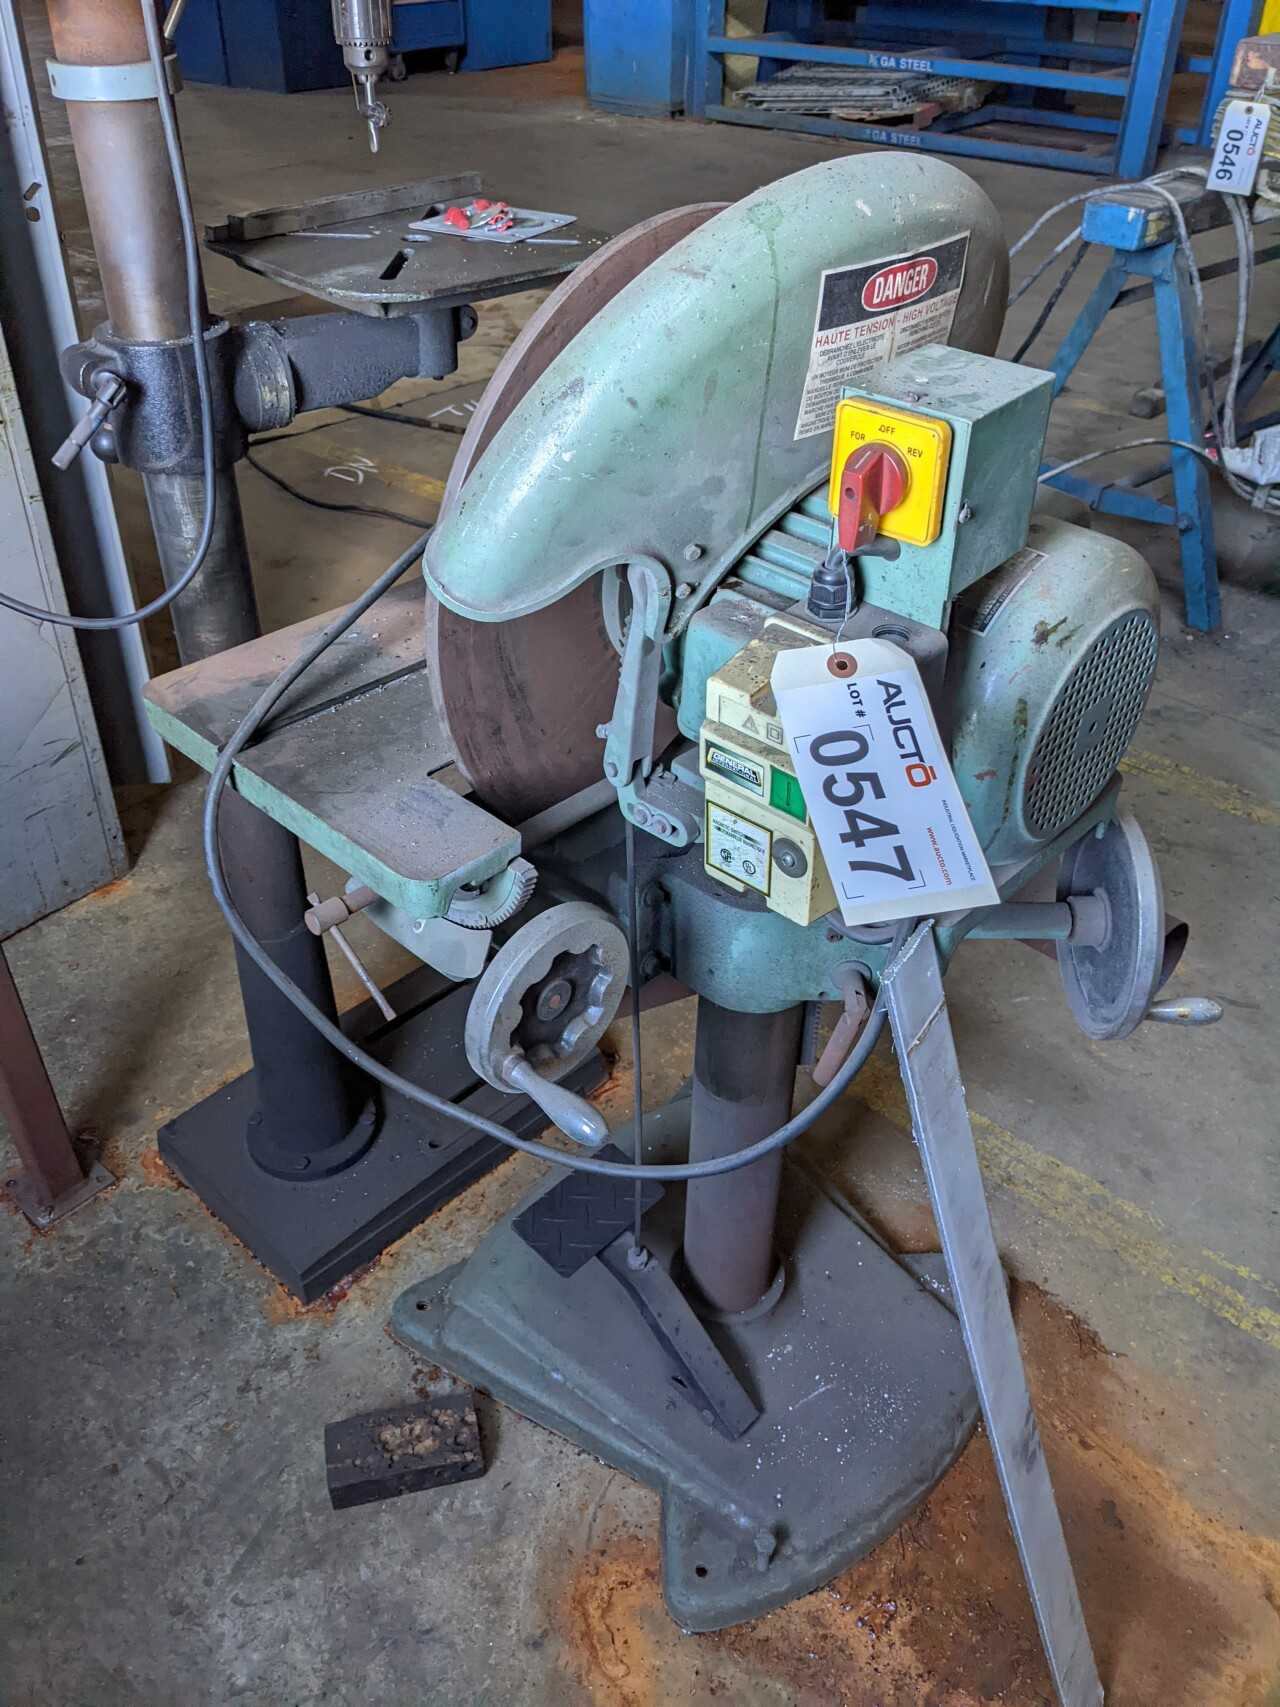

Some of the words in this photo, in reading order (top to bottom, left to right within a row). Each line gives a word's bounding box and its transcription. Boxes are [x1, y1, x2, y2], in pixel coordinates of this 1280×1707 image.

[881, 56, 896, 67] GA
[900, 58, 933, 72] STEEL
[891, 132, 922, 145] STEEL
[1216, 130, 1244, 181] 0546
[872, 263, 929, 304] DANGER
[815, 329, 851, 349] HAUTE
[854, 314, 896, 337] TENSION
[903, 308, 923, 324] HIGH
[850, 430, 866, 441] FOR
[879, 424, 896, 435] OFF
[907, 446, 923, 458] REV
[847, 682, 863, 706] LOT
[855, 709, 866, 718] #
[809, 730, 916, 882] 0547
[926, 826, 953, 886] www.aucto.com
